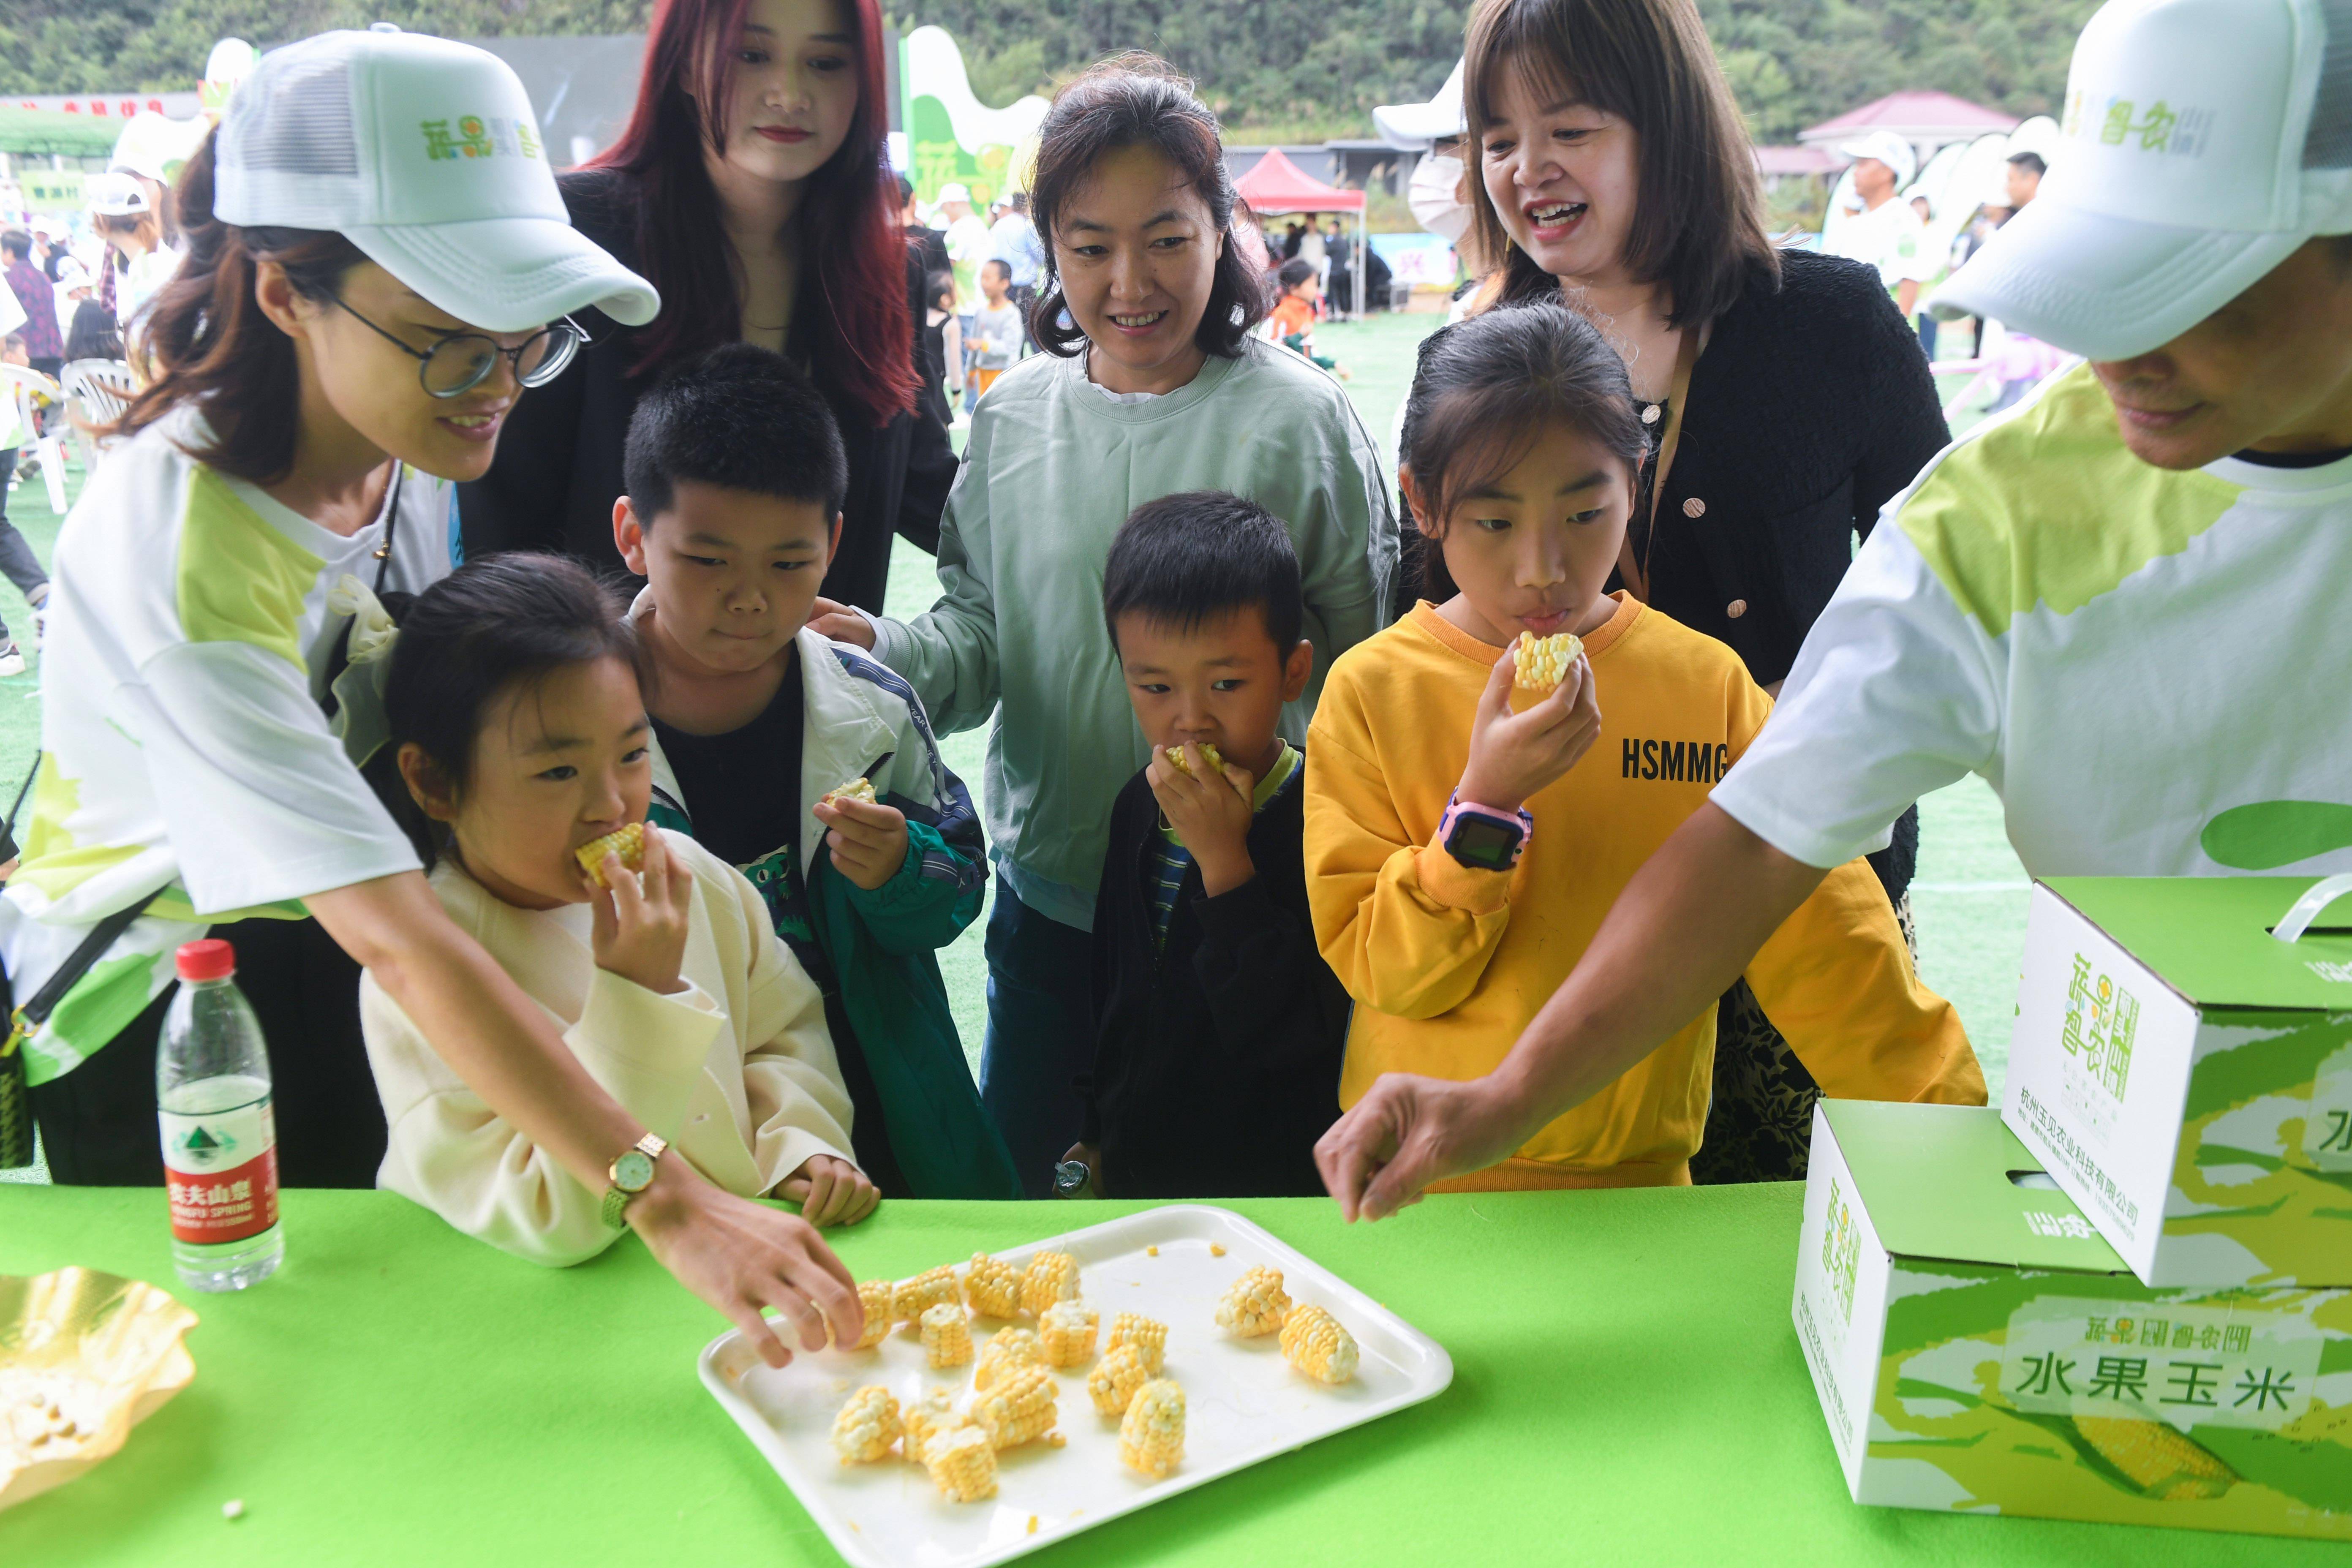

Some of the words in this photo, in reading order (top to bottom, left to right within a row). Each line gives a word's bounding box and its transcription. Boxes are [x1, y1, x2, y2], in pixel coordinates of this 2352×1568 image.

[2020, 1086, 2138, 1226] 杭州玉见农业科技有限公司
[210, 1200, 253, 1217] SPRING
[2015, 1352, 2295, 1412] 水果玉米
